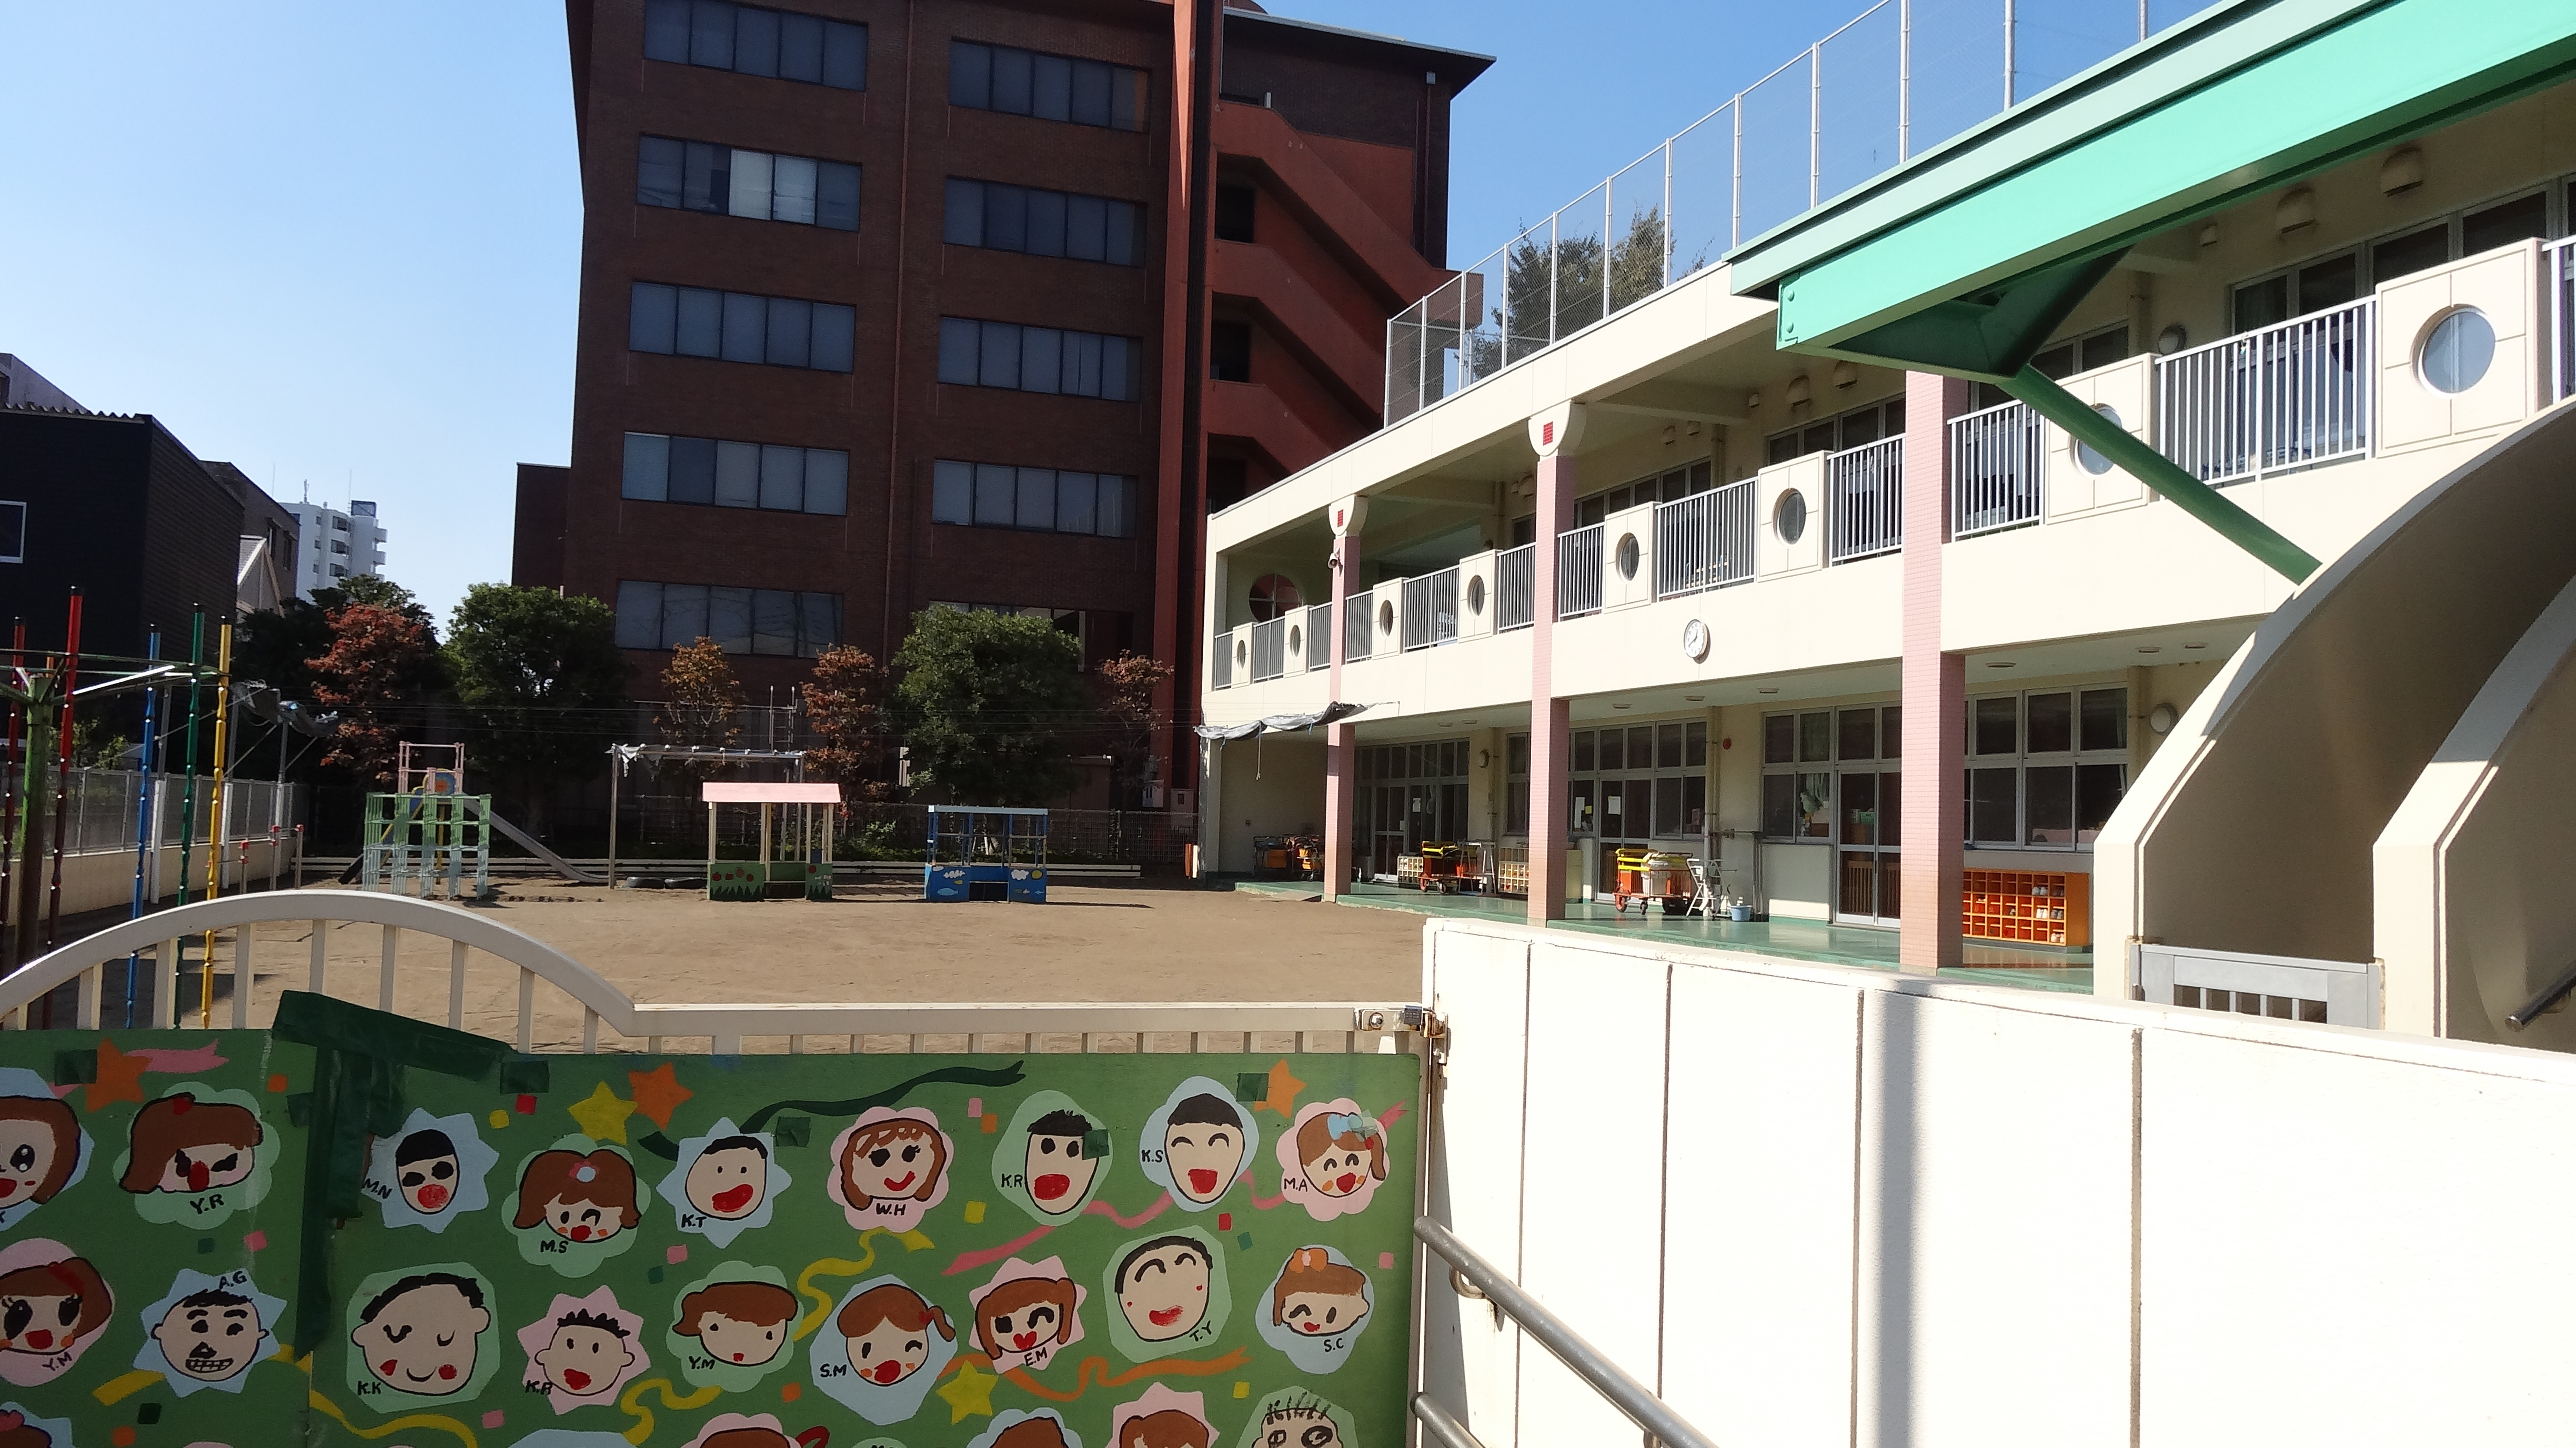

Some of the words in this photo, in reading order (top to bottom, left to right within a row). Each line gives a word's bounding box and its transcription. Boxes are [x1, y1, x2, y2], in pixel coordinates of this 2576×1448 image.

[1141, 1150, 1164, 1163] K.S
[1001, 1173, 1023, 1188] K.R
[1284, 1178, 1308, 1192] M.A
[364, 1178, 393, 1200] M.N
[190, 1194, 225, 1214] Y.R
[876, 1203, 906, 1216] W.H
[681, 1213, 707, 1228] K.T
[540, 1240, 569, 1253] M.S
[219, 1271, 247, 1290] A.G
[1189, 1320, 1214, 1342] T.Y
[1323, 1338, 1345, 1353] S.C
[42, 1352, 73, 1371] Y.M
[688, 1356, 716, 1370] Y.M
[1024, 1347, 1048, 1366] E.M
[820, 1363, 847, 1379] S.M
[357, 1380, 381, 1396] K.K
[525, 1380, 553, 1395] K.R
